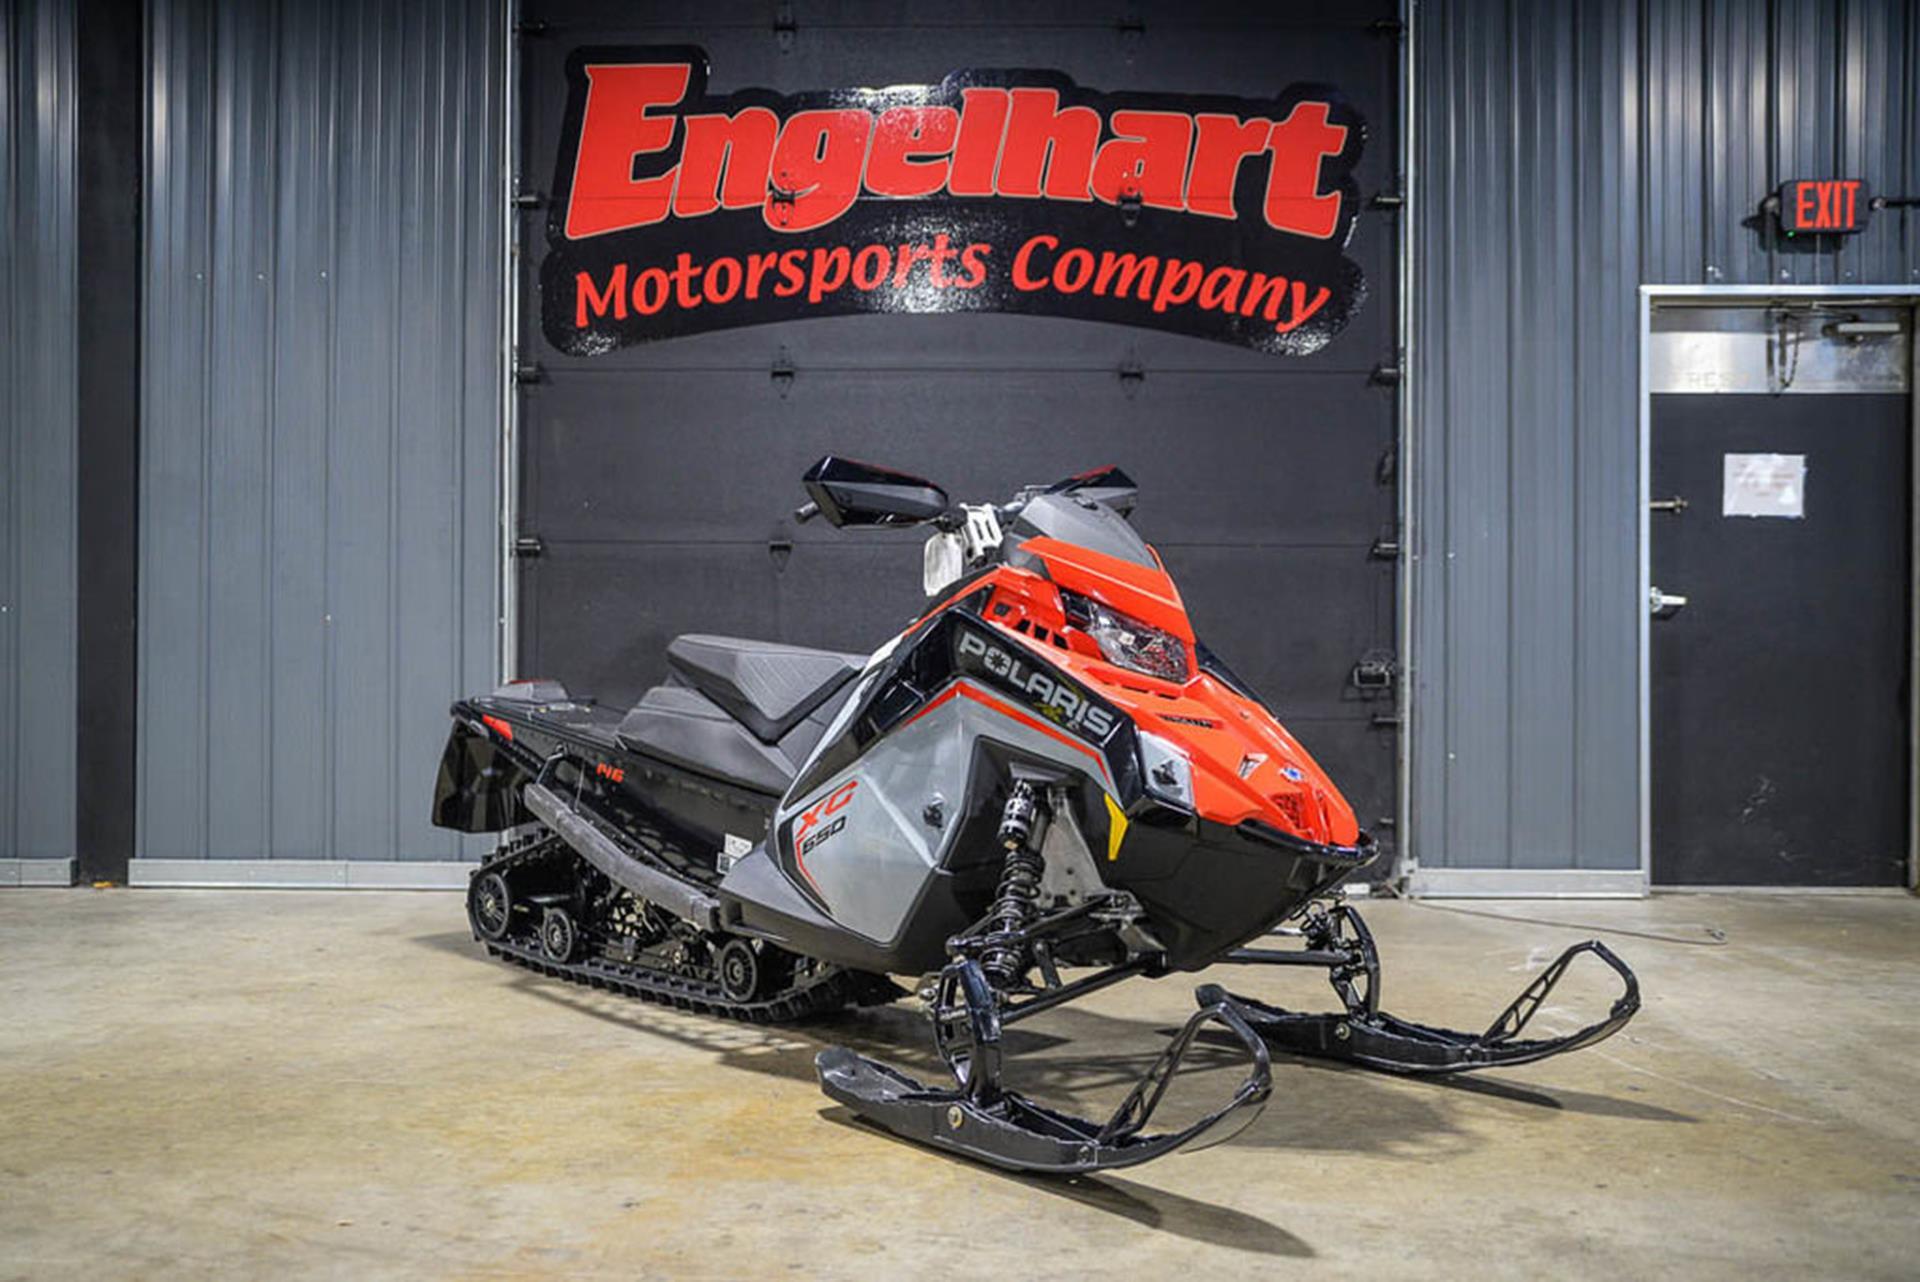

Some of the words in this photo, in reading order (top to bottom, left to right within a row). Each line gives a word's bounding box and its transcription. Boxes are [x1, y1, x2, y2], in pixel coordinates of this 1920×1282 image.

[565, 63, 1348, 240] Engelhart
[1795, 181, 1861, 229] EXIT
[574, 232, 992, 330] Motorsports
[1011, 233, 1332, 334] Company
[958, 630, 1115, 737] POLARIS
[802, 815, 847, 856] 650
